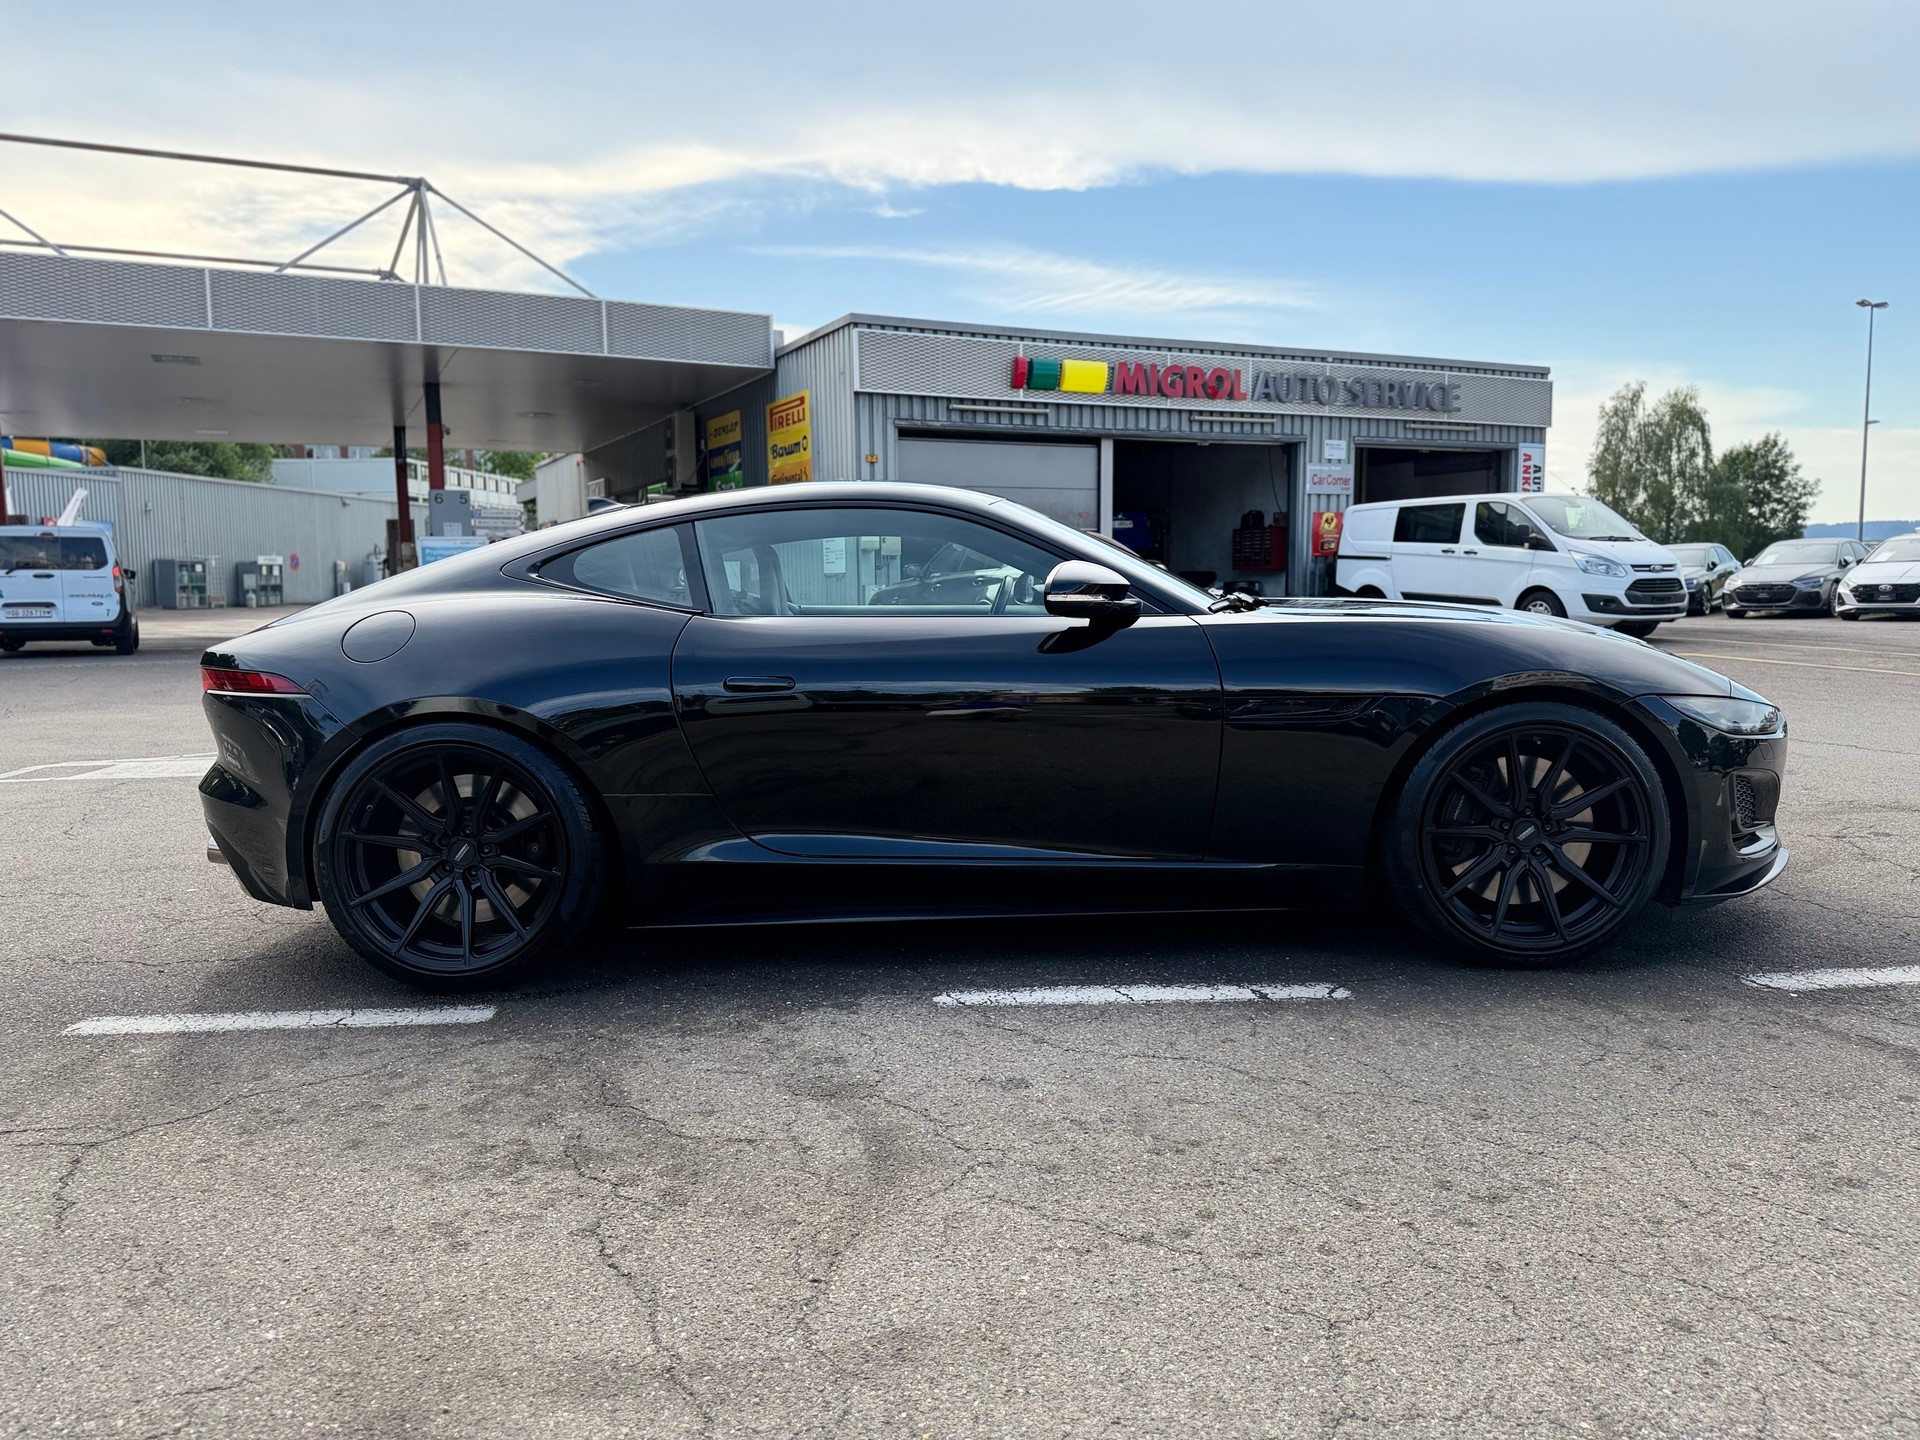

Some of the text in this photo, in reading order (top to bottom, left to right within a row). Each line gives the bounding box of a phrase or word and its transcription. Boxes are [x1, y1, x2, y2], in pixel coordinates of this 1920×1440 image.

[1114, 361, 1461, 412] MIGROL AUTO SERVICE
[769, 395, 806, 432] PIRELLI
[713, 421, 739, 438] DUNLOP
[770, 440, 801, 460] Barum
[434, 493, 444, 504] 6
[459, 494, 468, 505] 5
